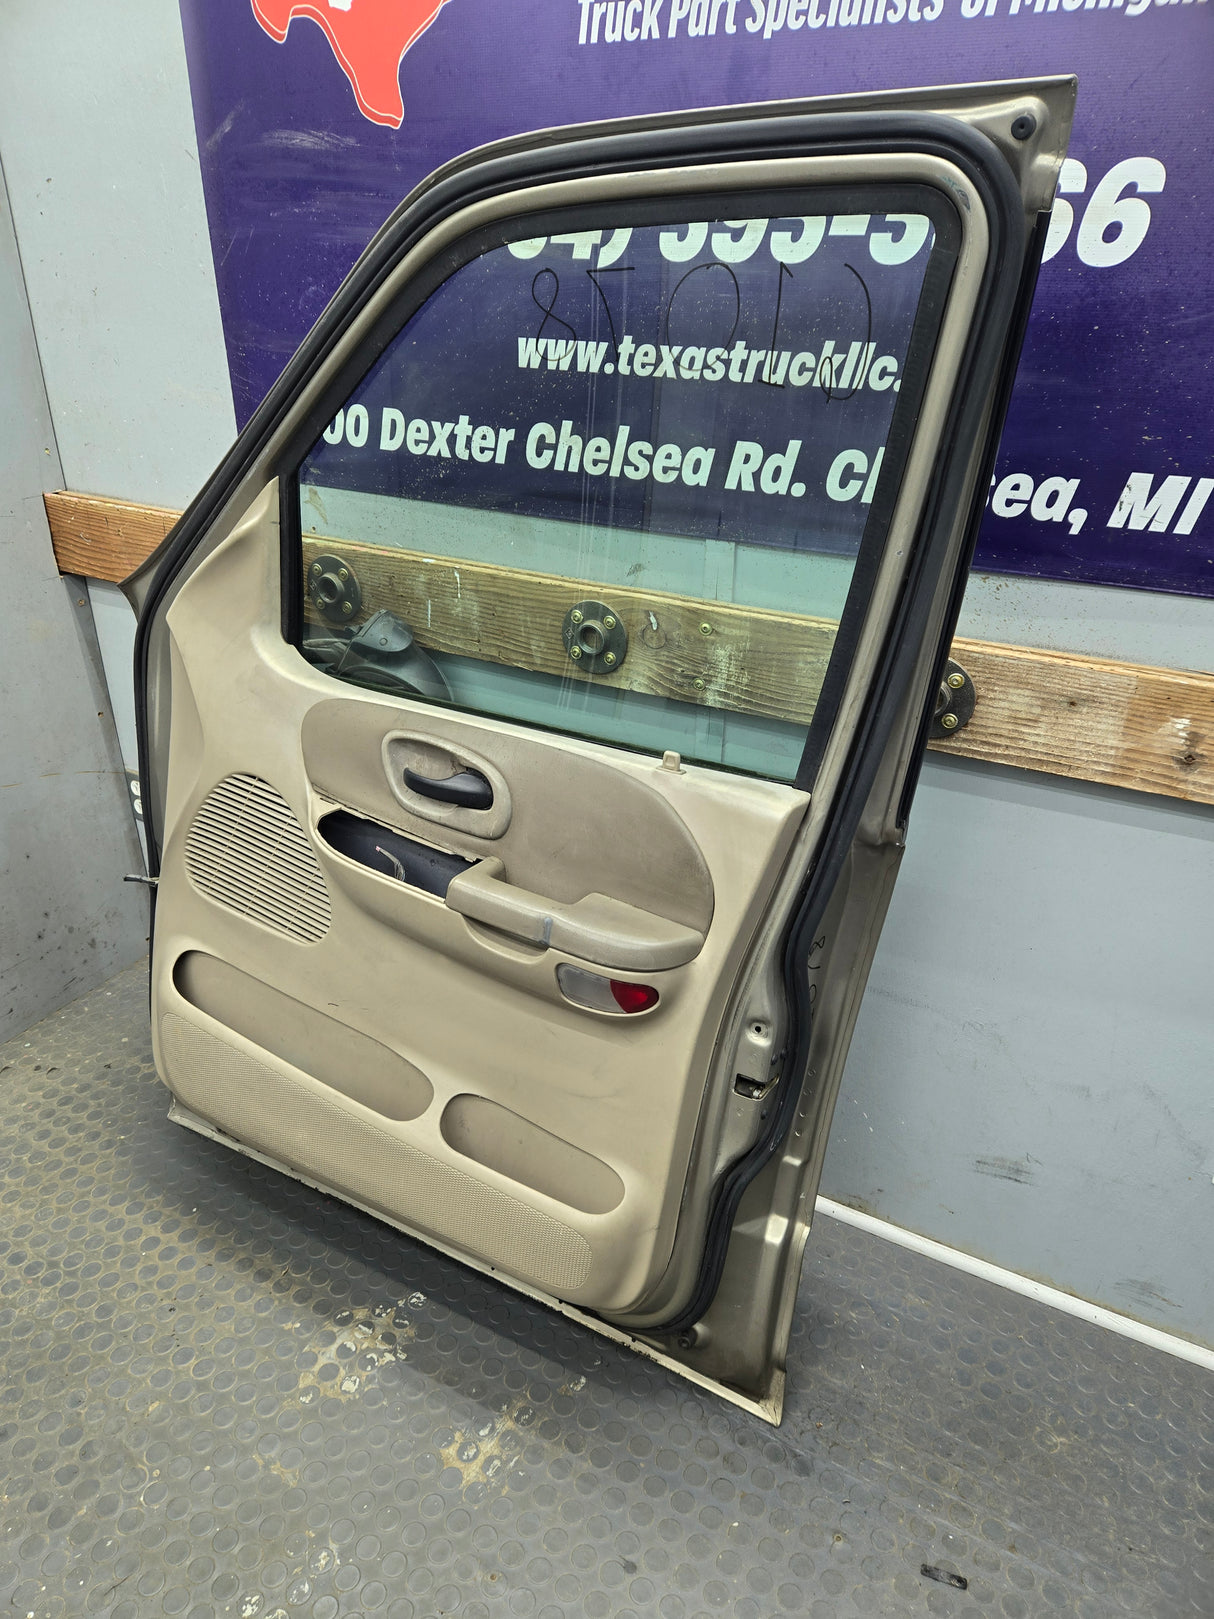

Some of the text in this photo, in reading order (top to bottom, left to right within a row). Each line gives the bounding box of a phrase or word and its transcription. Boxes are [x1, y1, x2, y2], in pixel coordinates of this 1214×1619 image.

[578, 0, 661, 44] Truck
[667, 0, 740, 38] Part
[380, 407, 515, 465] Dexter
[526, 420, 716, 487] Chelsea
[724, 440, 807, 497] Rd.
[1106, 472, 1214, 535] MI
